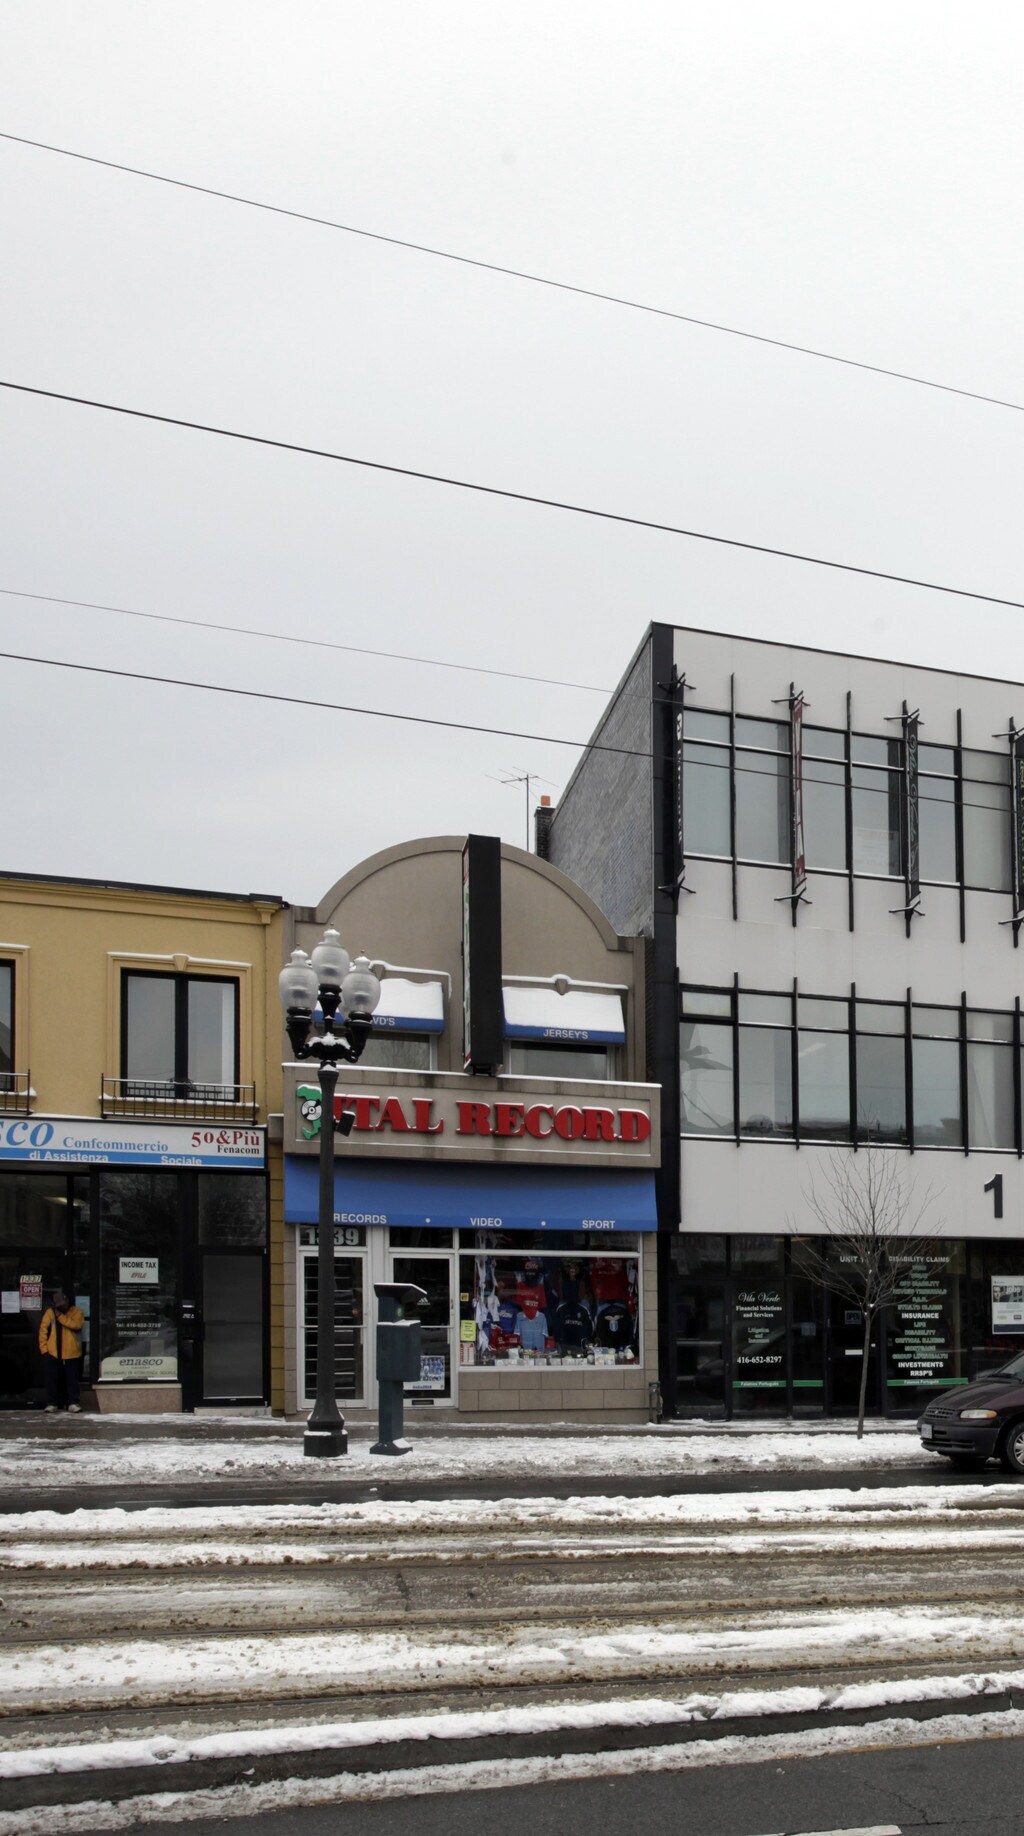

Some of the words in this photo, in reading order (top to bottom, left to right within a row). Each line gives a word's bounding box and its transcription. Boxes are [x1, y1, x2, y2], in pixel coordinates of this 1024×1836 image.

[372, 1016, 395, 1027] VD'S
[543, 1028, 589, 1040] JERSEY'S
[456, 1100, 652, 1142] RECORD
[63, 1136, 168, 1152] Confcommercio
[191, 1130, 260, 1148] 50&Più
[217, 1144, 260, 1154] Fenacom
[29, 1150, 41, 1160] di
[44, 1151, 109, 1162] Assistenza
[160, 1154, 202, 1165] Sociale
[333, 1212, 387, 1225] RECORDS
[469, 1217, 503, 1228] VIDEO
[582, 1219, 616, 1230] SPORT
[305, 1227, 359, 1246] 139
[121, 1261, 144, 1269] INCOME
[145, 1261, 157, 1269] TAX
[119, 1357, 163, 1366] enasco
[737, 1356, 783, 1364] 416-652-8297
